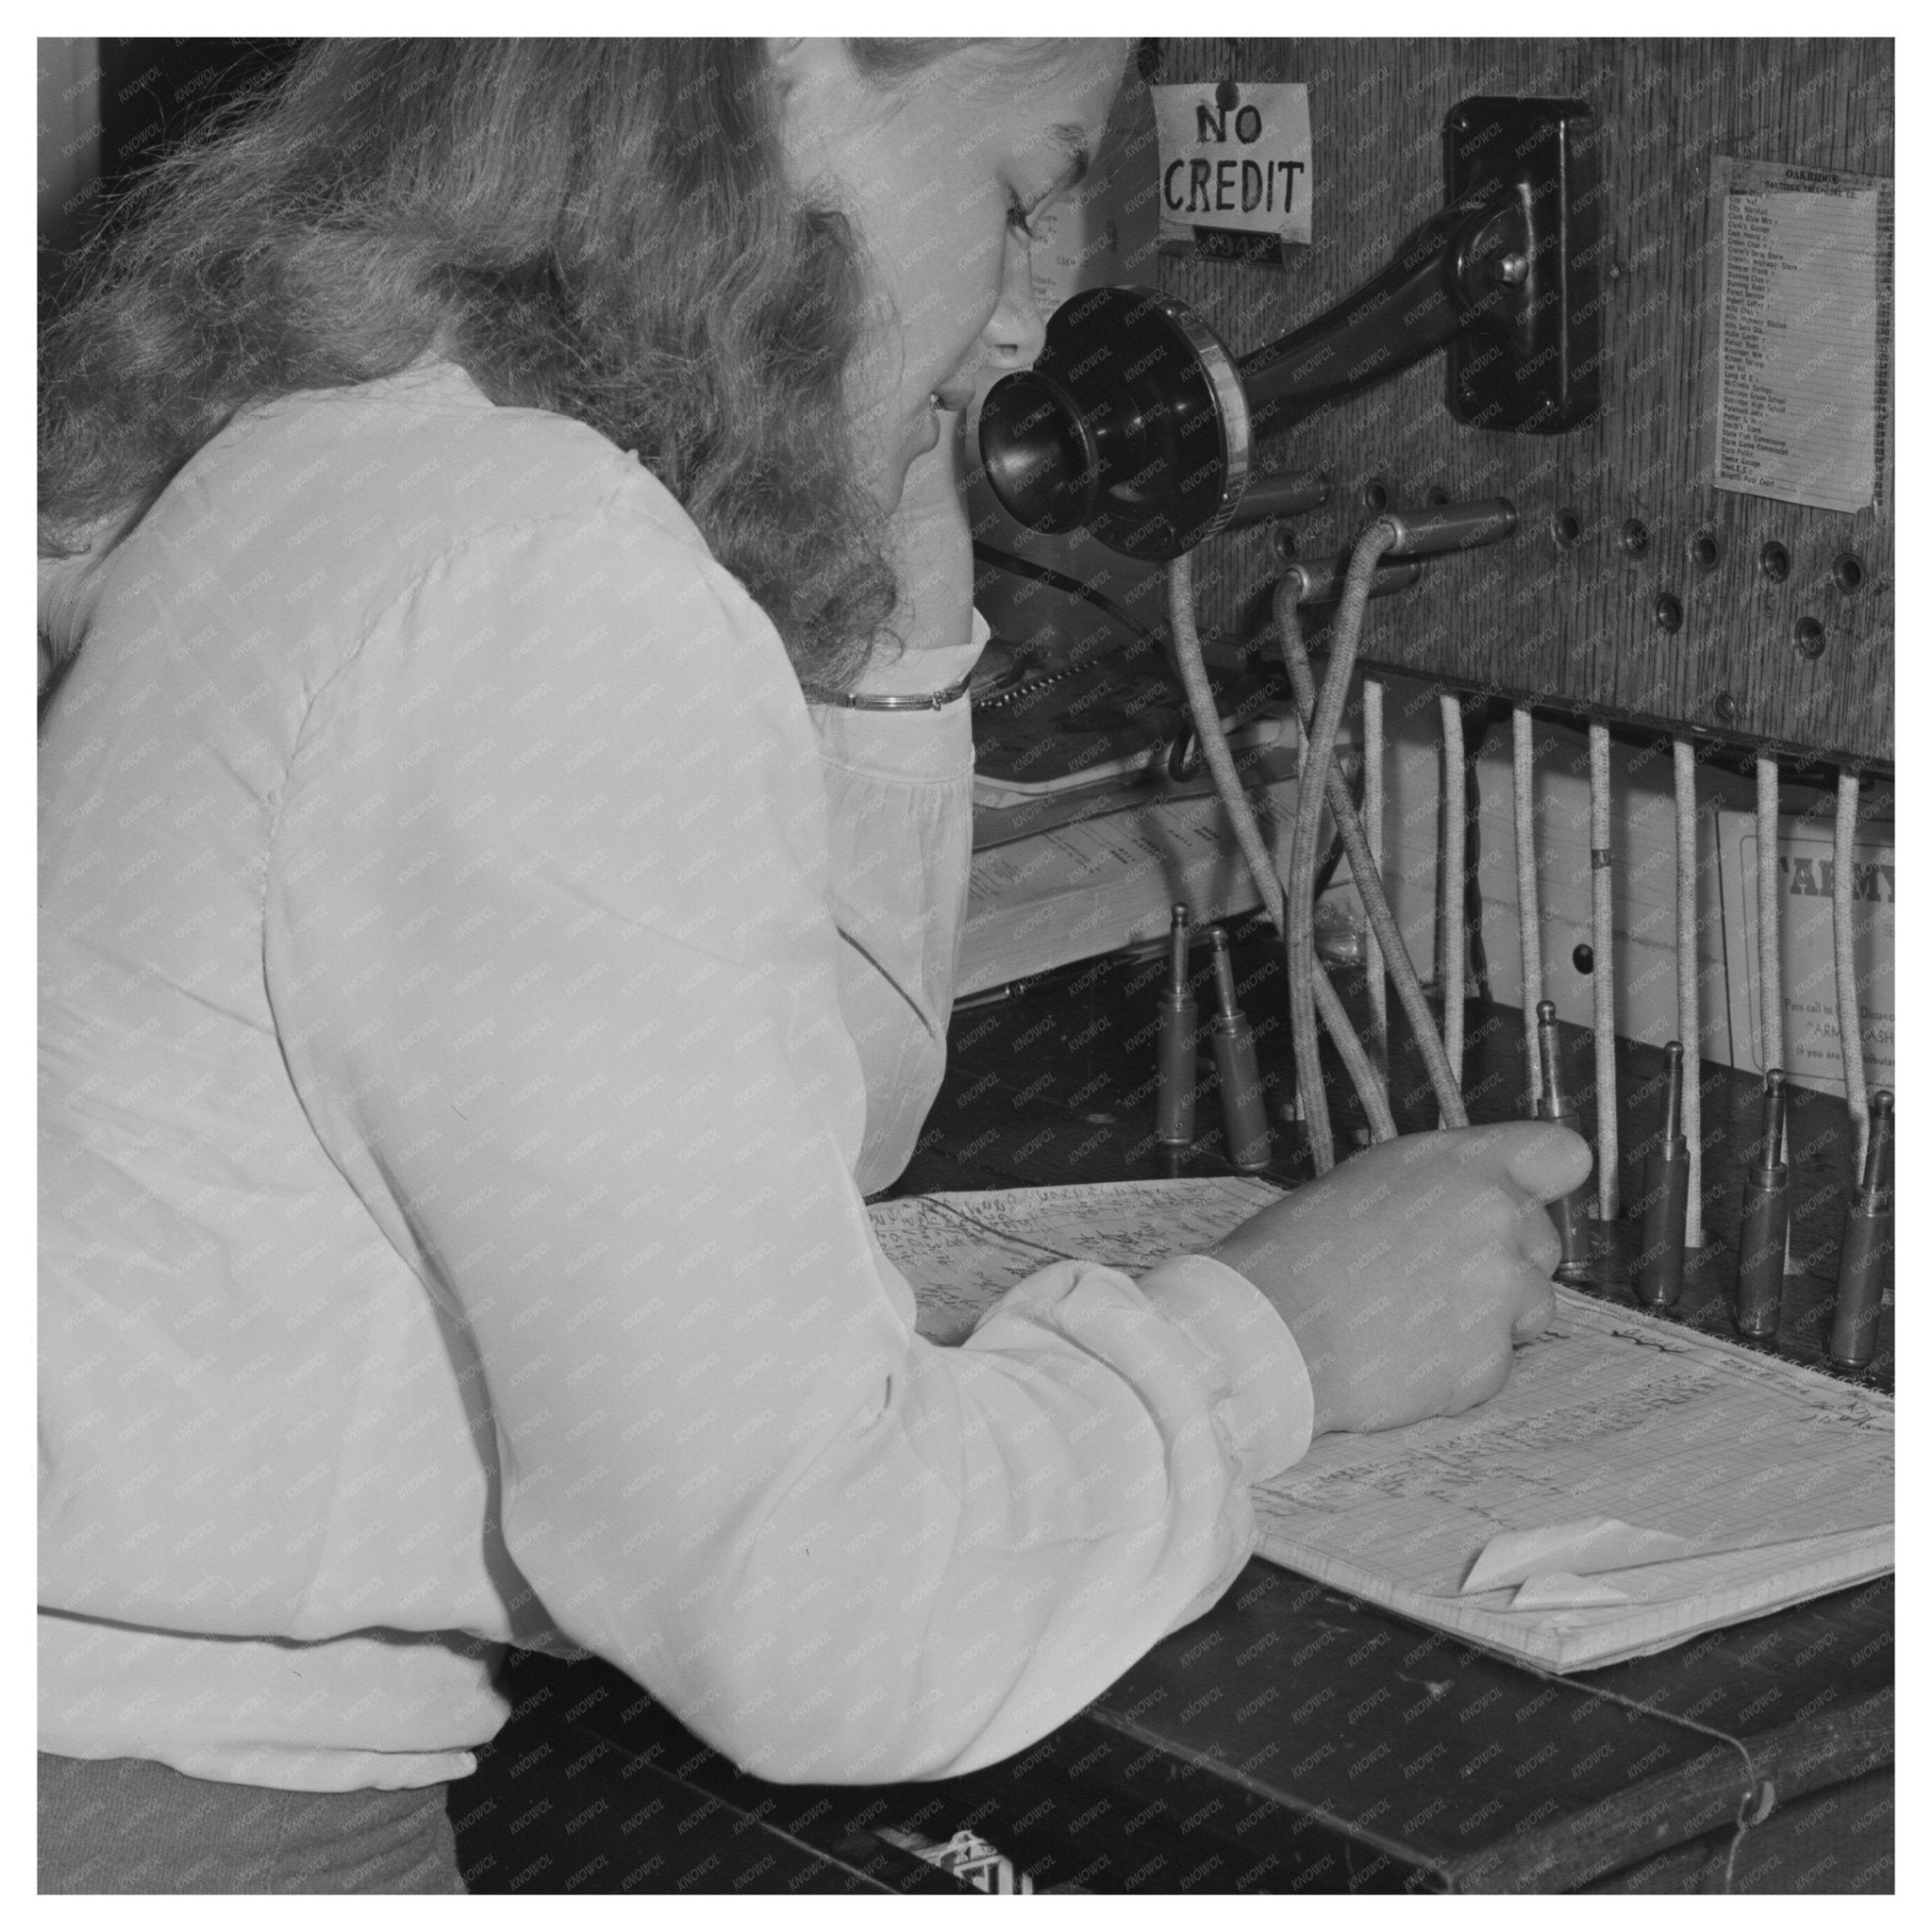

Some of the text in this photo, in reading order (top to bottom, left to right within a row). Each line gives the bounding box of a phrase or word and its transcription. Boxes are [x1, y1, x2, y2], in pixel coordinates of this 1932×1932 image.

[1196, 104, 1262, 144] NO
[1164, 158, 1305, 213] CREDIT
[1807, 1001, 1821, 1013] call
[1824, 1005, 1833, 1015] to
[1807, 1049, 1824, 1058] you
[1826, 1052, 1840, 1060] are
